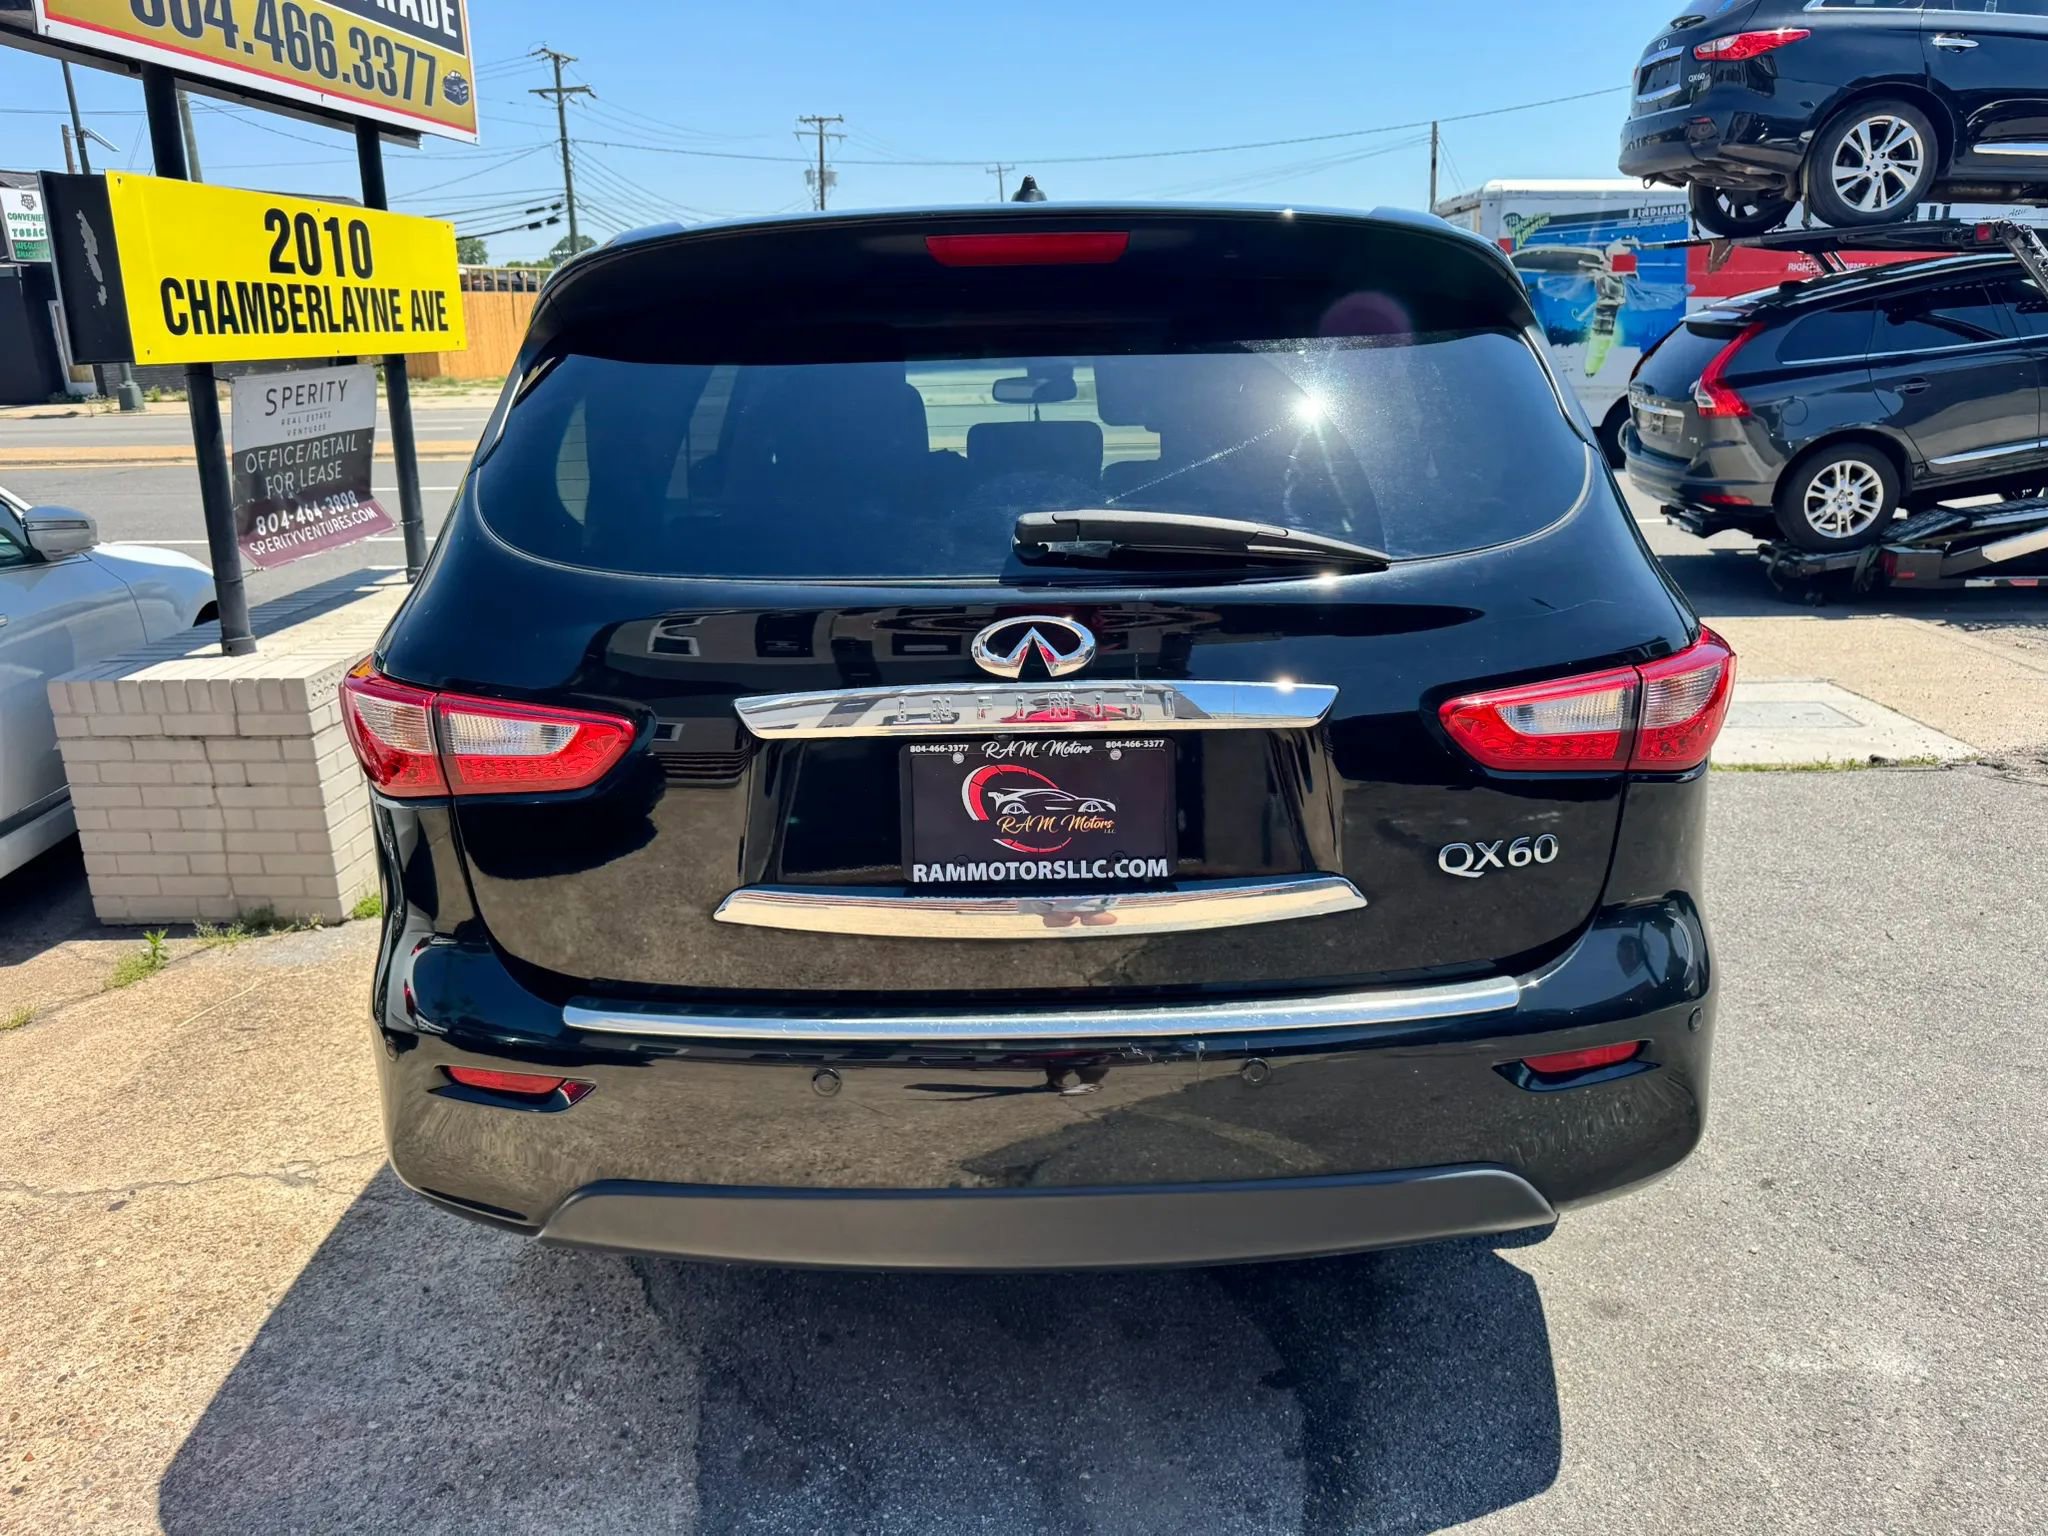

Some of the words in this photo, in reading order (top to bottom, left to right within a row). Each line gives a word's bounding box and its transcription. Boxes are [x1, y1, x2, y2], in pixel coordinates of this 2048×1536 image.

[1637, 205, 1685, 217] INDIANA
[264, 208, 374, 280] 2010
[160, 277, 404, 336] CHAMBERLAYNE
[411, 290, 449, 332] AVE
[265, 379, 348, 417] SPERITY
[287, 423, 327, 436] VENTURES
[306, 410, 332, 423] ESTATE
[245, 433, 358, 474] OFFICE/RETAIL
[265, 471, 295, 497] FOR
[300, 460, 343, 488] LEASE
[256, 490, 359, 536] 804-464-3898
[249, 505, 378, 556] SPERITYVENTURES.COM
[898, 690, 1175, 723] INFINITI
[909, 744, 969, 753] 804-466-3377
[981, 741, 1040, 758] RAM
[1042, 741, 1093, 758] Motors
[1105, 740, 1165, 749] 804-466-3377
[996, 815, 1059, 834] RAM
[1060, 815, 1115, 832] Motors
[912, 859, 1169, 883] RAMMOTORSLLC.COM
[1438, 833, 1559, 878] QX60
